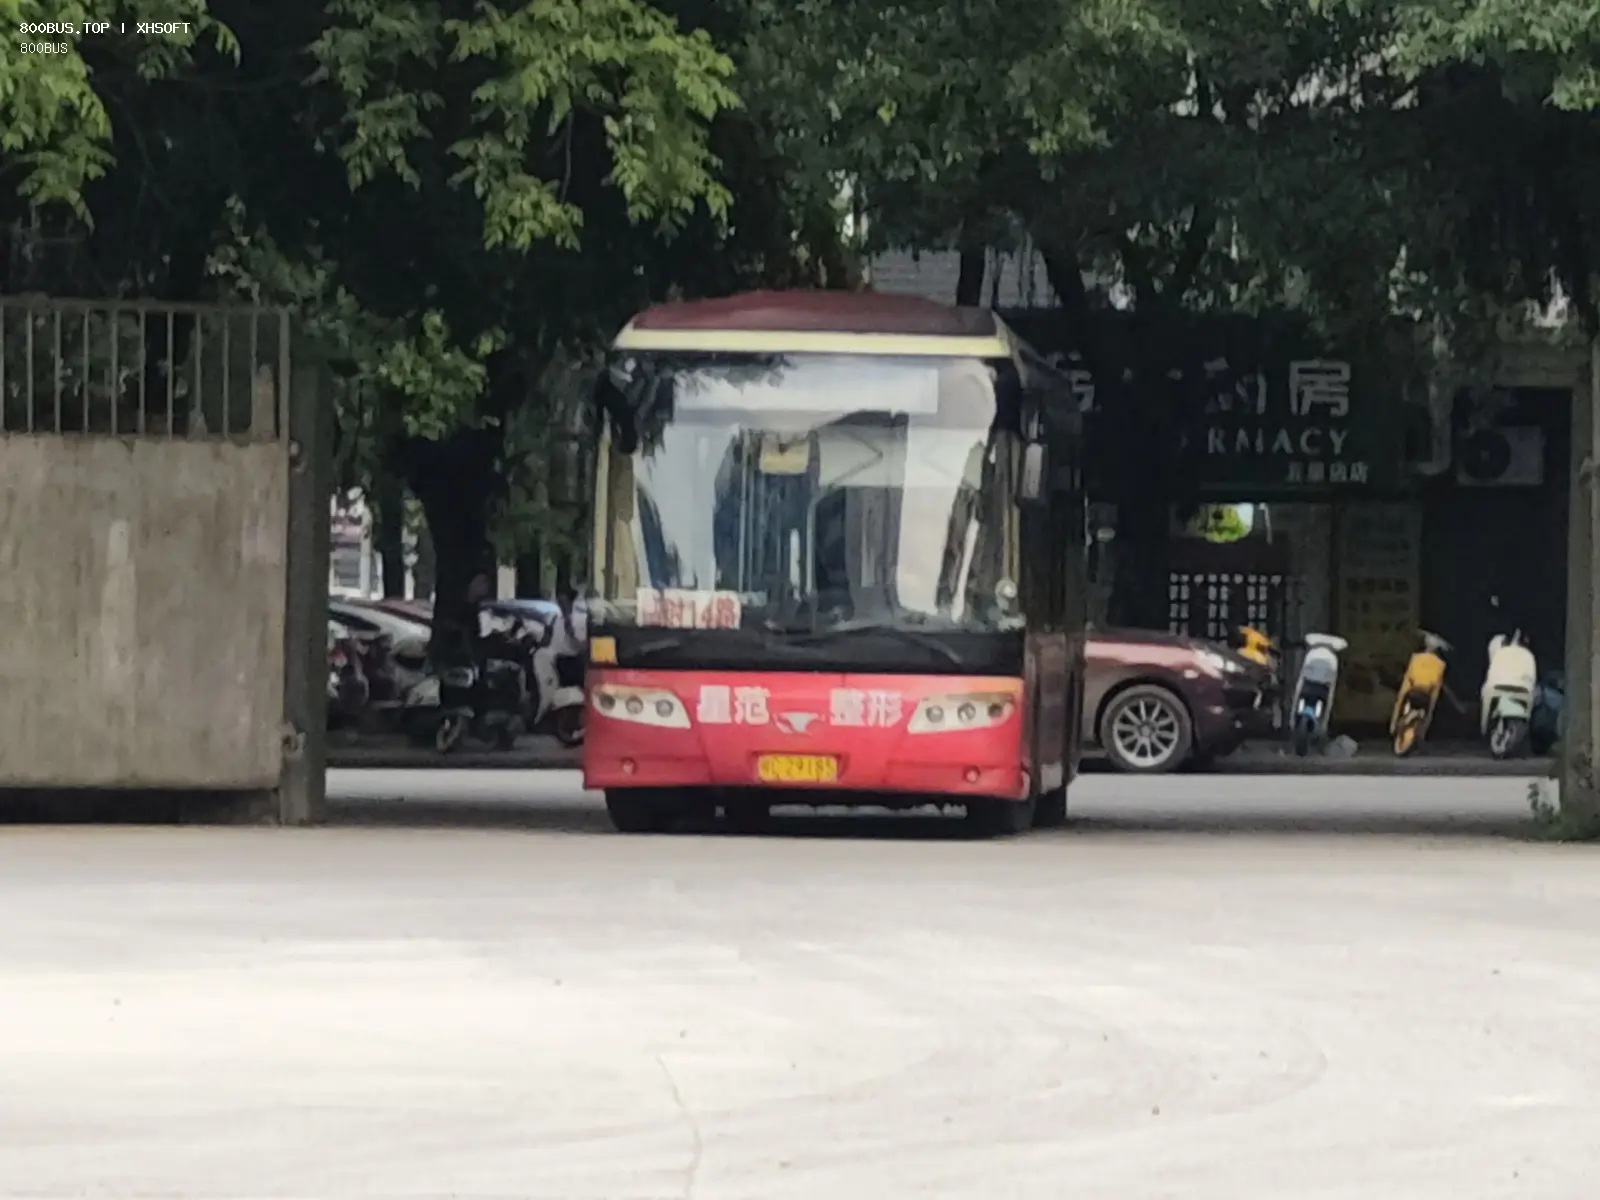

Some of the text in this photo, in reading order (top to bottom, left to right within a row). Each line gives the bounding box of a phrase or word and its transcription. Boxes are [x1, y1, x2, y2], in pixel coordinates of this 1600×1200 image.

[1181, 427, 1348, 455] RMACY
[697, 684, 903, 728] 星范 整形
